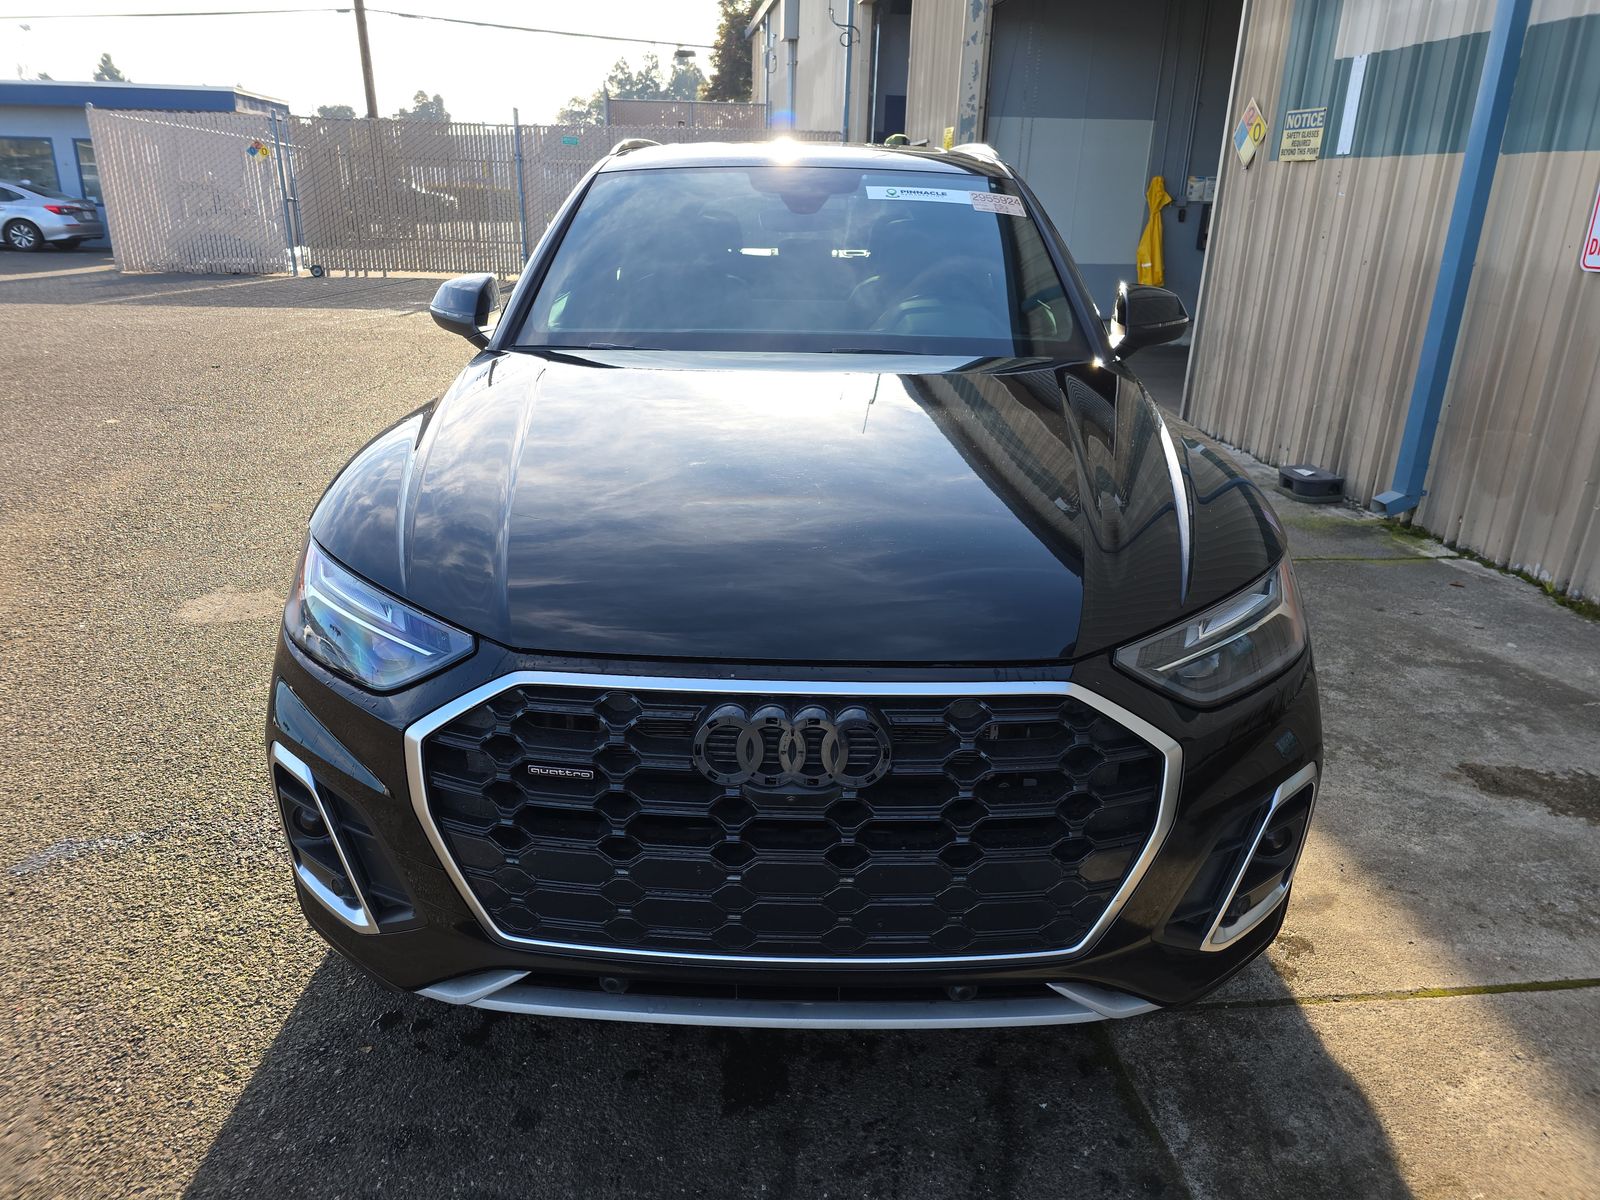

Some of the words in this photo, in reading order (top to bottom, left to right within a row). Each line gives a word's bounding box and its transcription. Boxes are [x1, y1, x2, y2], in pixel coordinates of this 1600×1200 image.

[1247, 107, 1255, 127] 2
[1286, 112, 1325, 129] NOTICE
[1253, 123, 1262, 142] 0
[1286, 131, 1301, 139] SAFETY
[1301, 130, 1319, 139] GLASSES
[1291, 139, 1312, 147] REQUIRED
[1280, 148, 1297, 156] BEYOND
[1306, 147, 1319, 155] POINT
[971, 192, 1021, 207] 2955924
[1588, 238, 1600, 255] D
[530, 767, 591, 778] quattro
